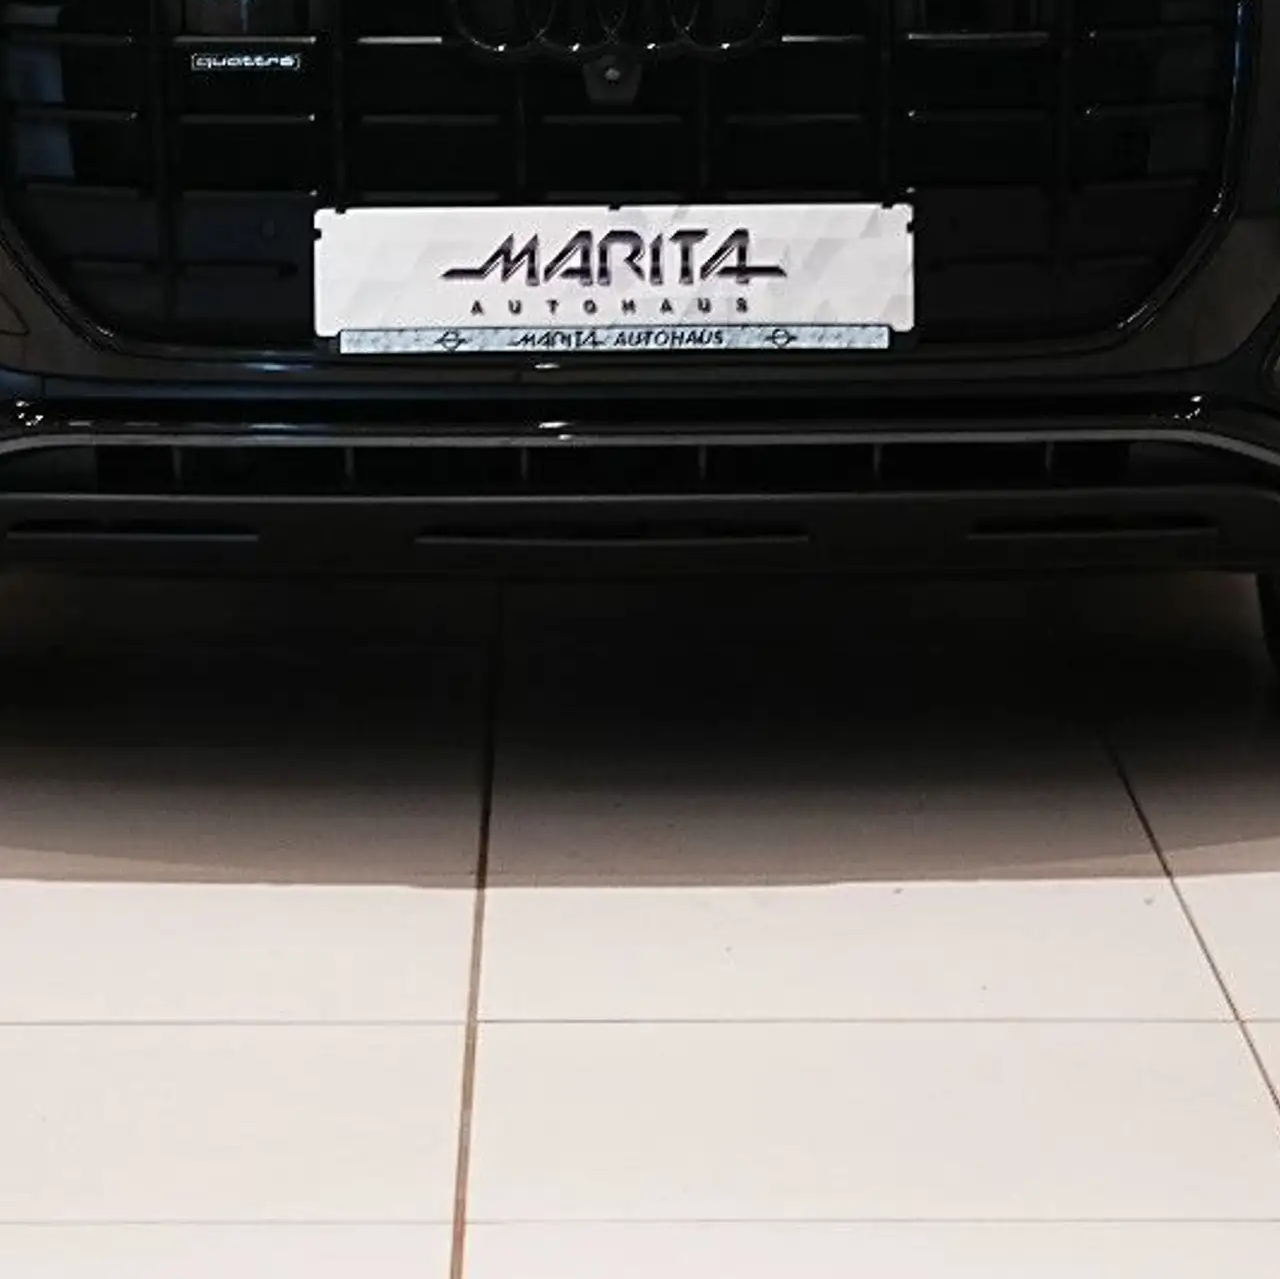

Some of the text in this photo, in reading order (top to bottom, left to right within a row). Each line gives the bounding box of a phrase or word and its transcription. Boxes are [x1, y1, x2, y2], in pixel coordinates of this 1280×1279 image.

[195, 54, 295, 69] quattro
[441, 229, 788, 287] MARITA
[469, 297, 750, 315] AUTOHAUS
[509, 329, 725, 347] MARITA AUTOHAUS
